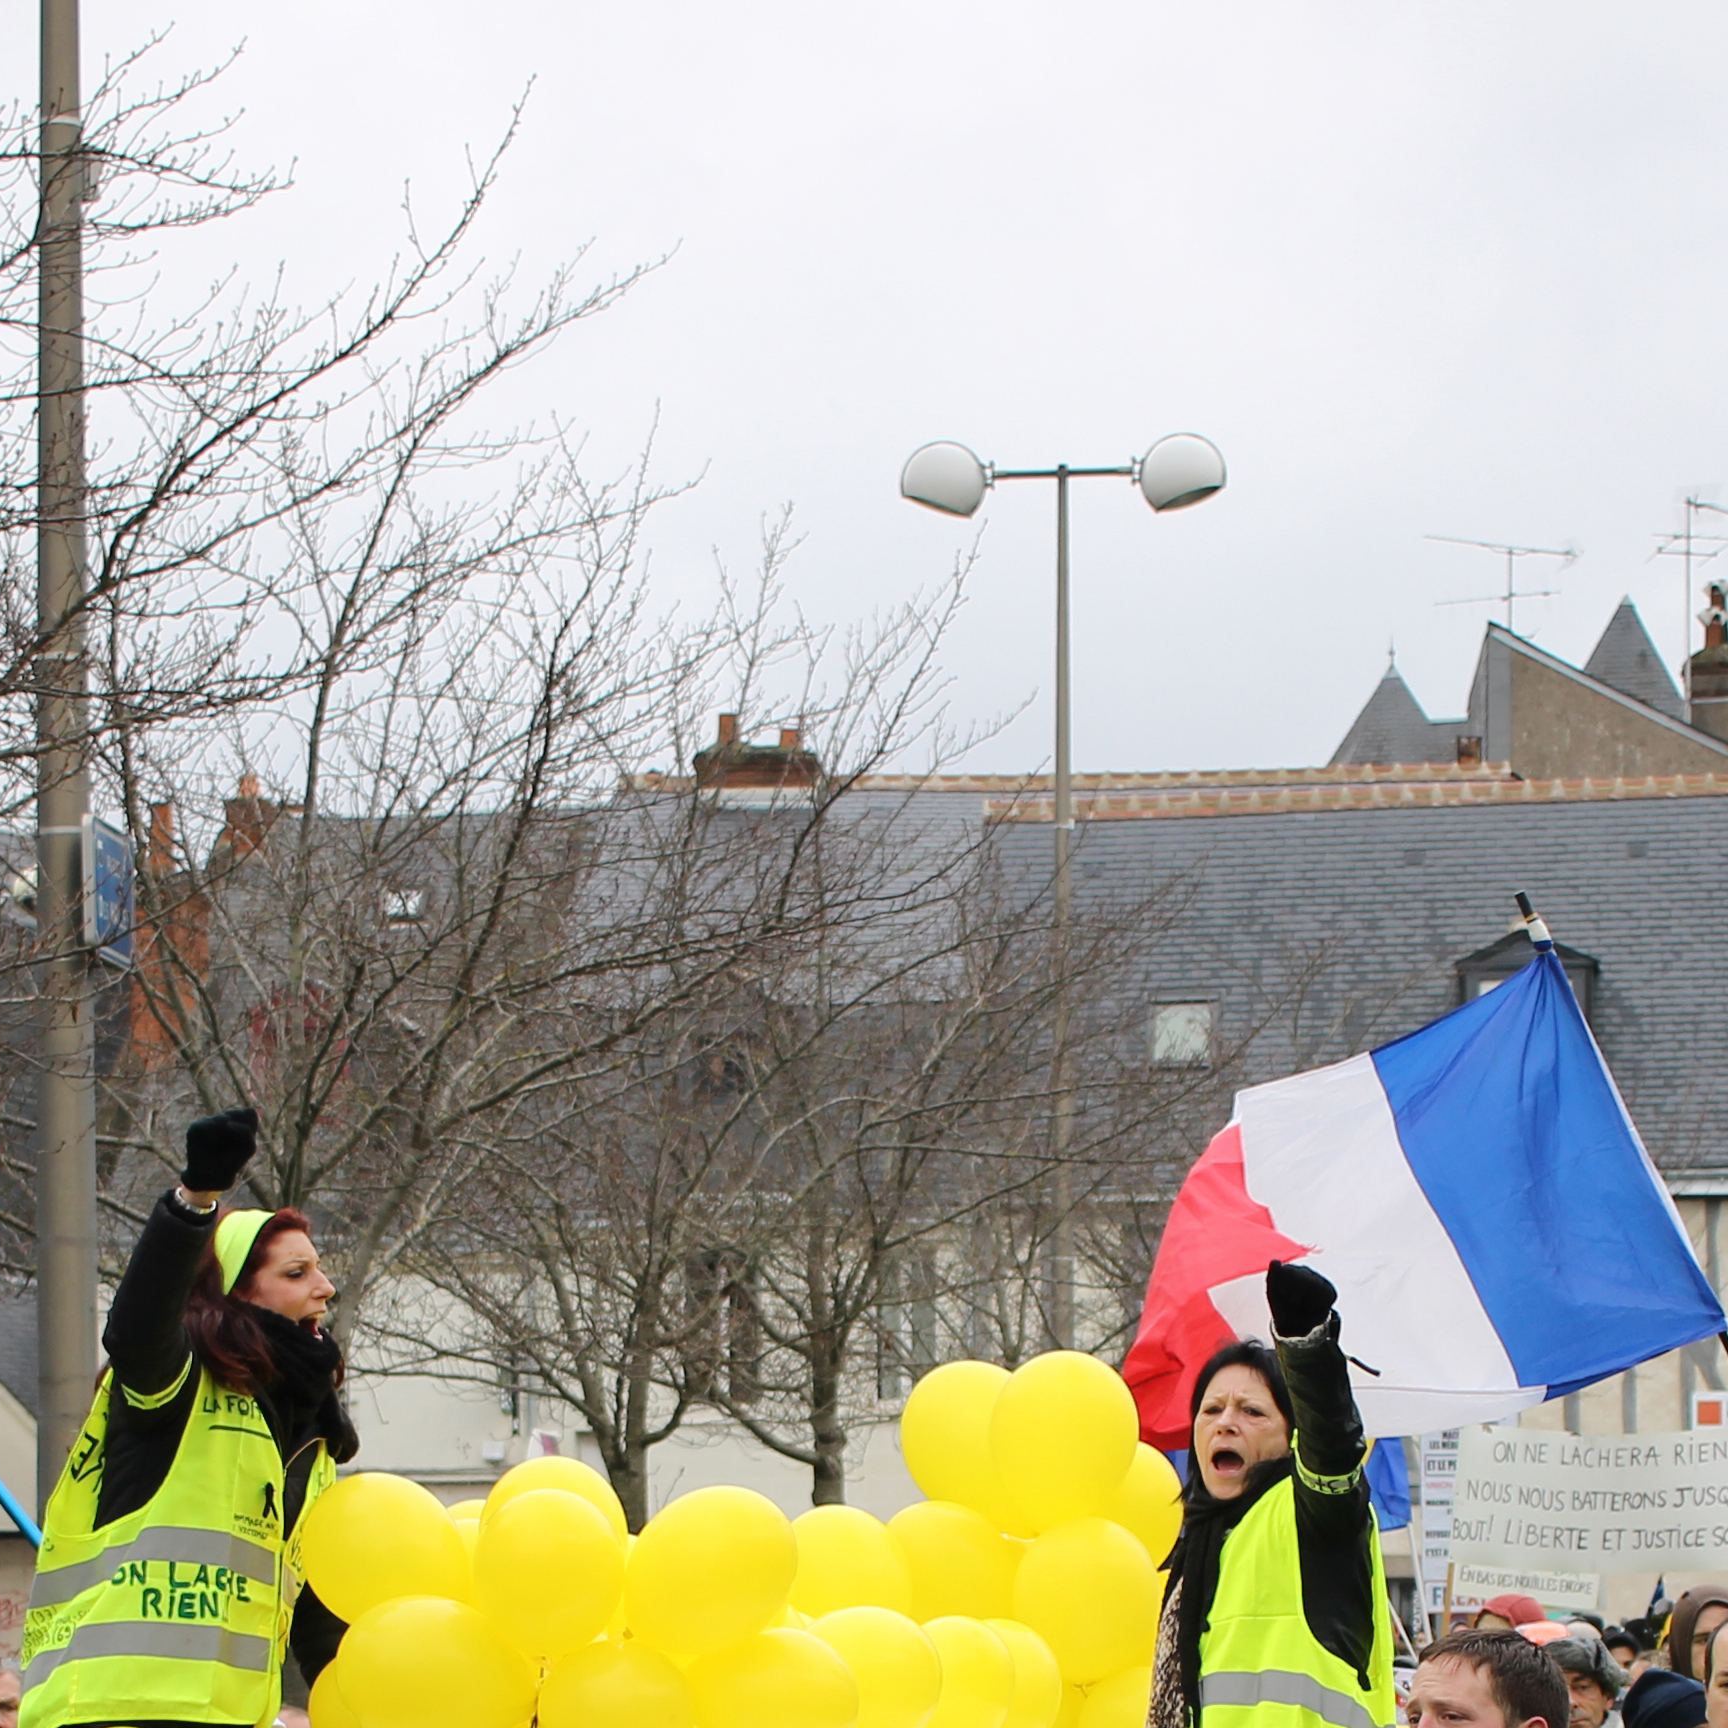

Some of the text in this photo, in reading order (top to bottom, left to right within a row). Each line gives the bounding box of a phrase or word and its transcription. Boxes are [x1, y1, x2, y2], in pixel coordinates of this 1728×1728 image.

[1493, 1441, 1518, 1464] ON
[1524, 1441, 1548, 1465] NE
[1561, 1441, 1661, 1469] LACHERA
[1467, 1479, 1512, 1505] NOUS
[1518, 1485, 1566, 1512] NOUS
[1572, 1488, 1668, 1512] BATTERONS
[1602, 1528, 1627, 1551] ET
